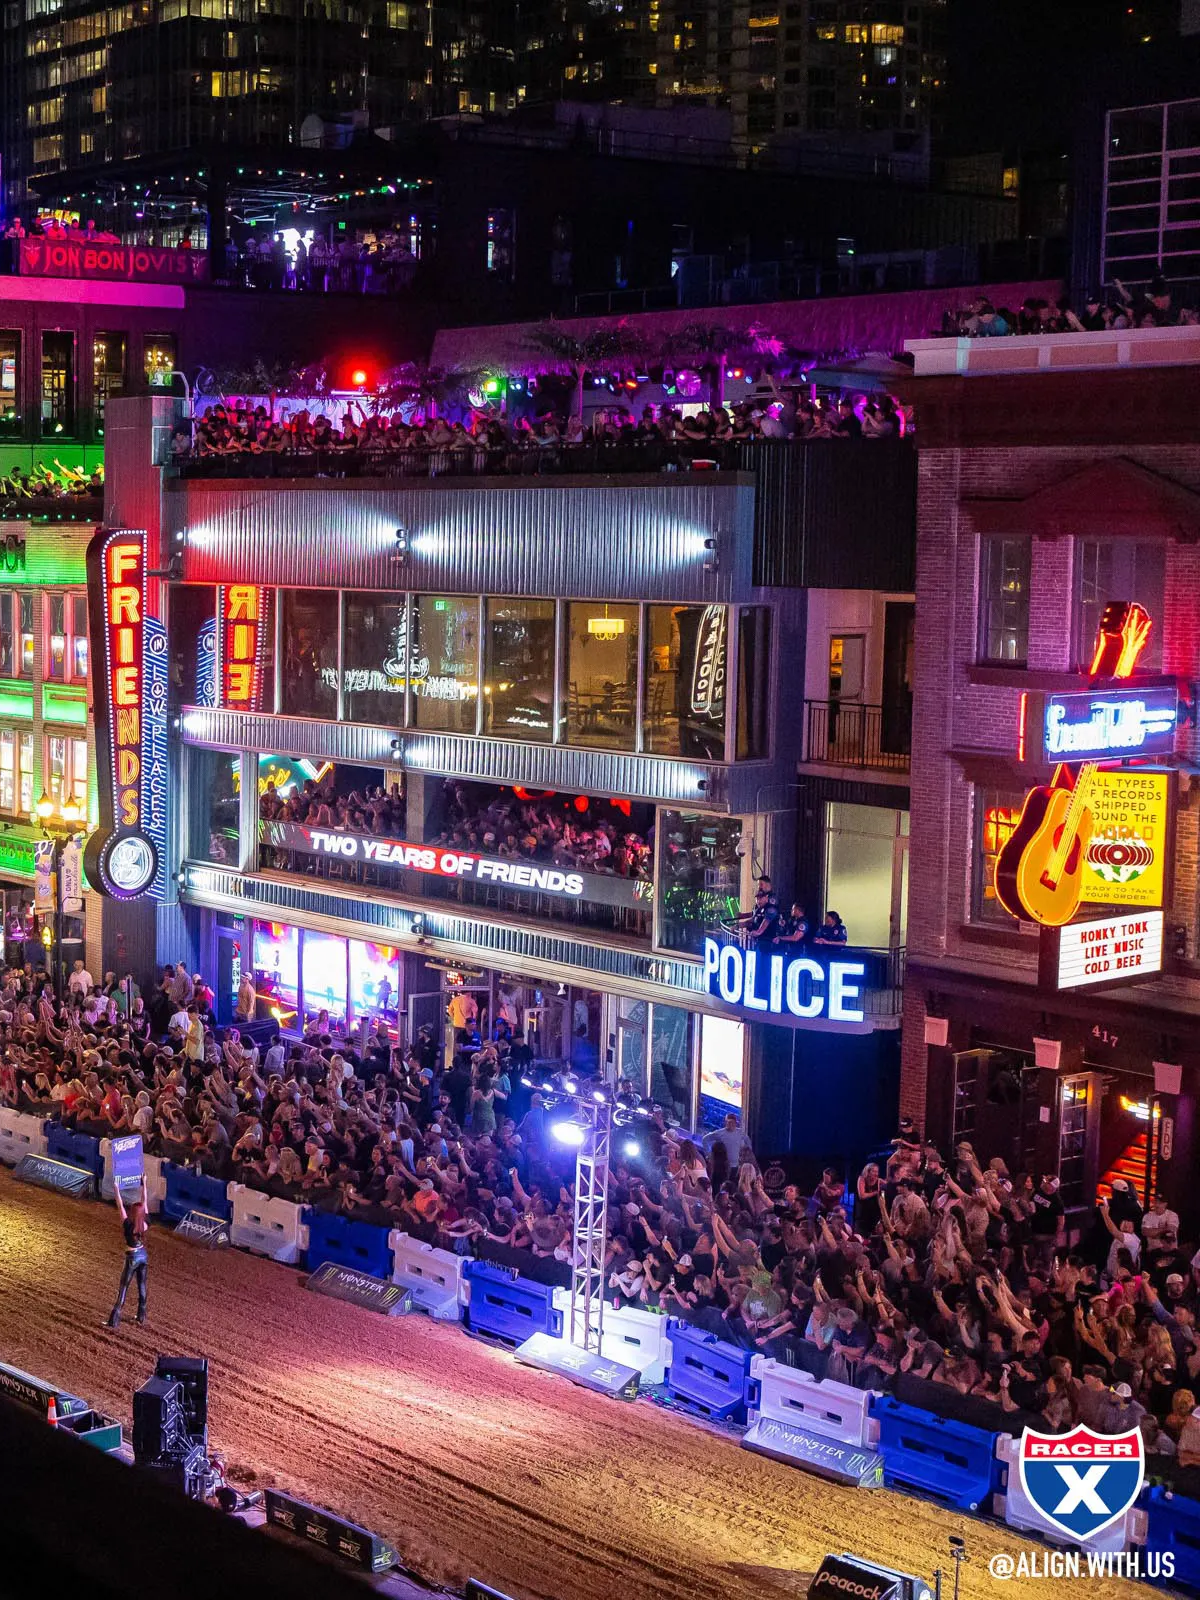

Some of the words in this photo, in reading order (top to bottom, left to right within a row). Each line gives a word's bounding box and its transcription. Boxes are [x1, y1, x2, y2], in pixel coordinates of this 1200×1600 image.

[44, 246, 80, 273] JON
[84, 250, 125, 270] BON
[110, 544, 141, 826] FRIENDS
[150, 725, 162, 828] PLACES
[1116, 779, 1155, 789] TYPES
[1094, 800, 1147, 811] SHIPPED
[1103, 789, 1162, 801] RECORDS
[1091, 812, 1128, 822] OUND
[1134, 813, 1157, 823] THE
[0, 840, 34, 863] HONK
[310, 832, 357, 856] TWO
[362, 840, 436, 870] YEARS
[440, 853, 474, 874] OF
[477, 859, 584, 895] FRIENDS
[1085, 891, 1110, 899] YOUR
[1080, 926, 1116, 944] HONKY
[1121, 921, 1149, 937] TONK
[1085, 944, 1108, 959] LIVE
[1114, 938, 1144, 954] MUSIC
[1085, 960, 1110, 975] COLD
[1116, 954, 1142, 970] BEER
[704, 936, 866, 1023] POLICE
[1091, 1024, 1119, 1047] 417
[337, 1272, 384, 1294] MONSTER
[782, 1431, 846, 1460] MONSTER
[815, 1571, 882, 1600] peacock
